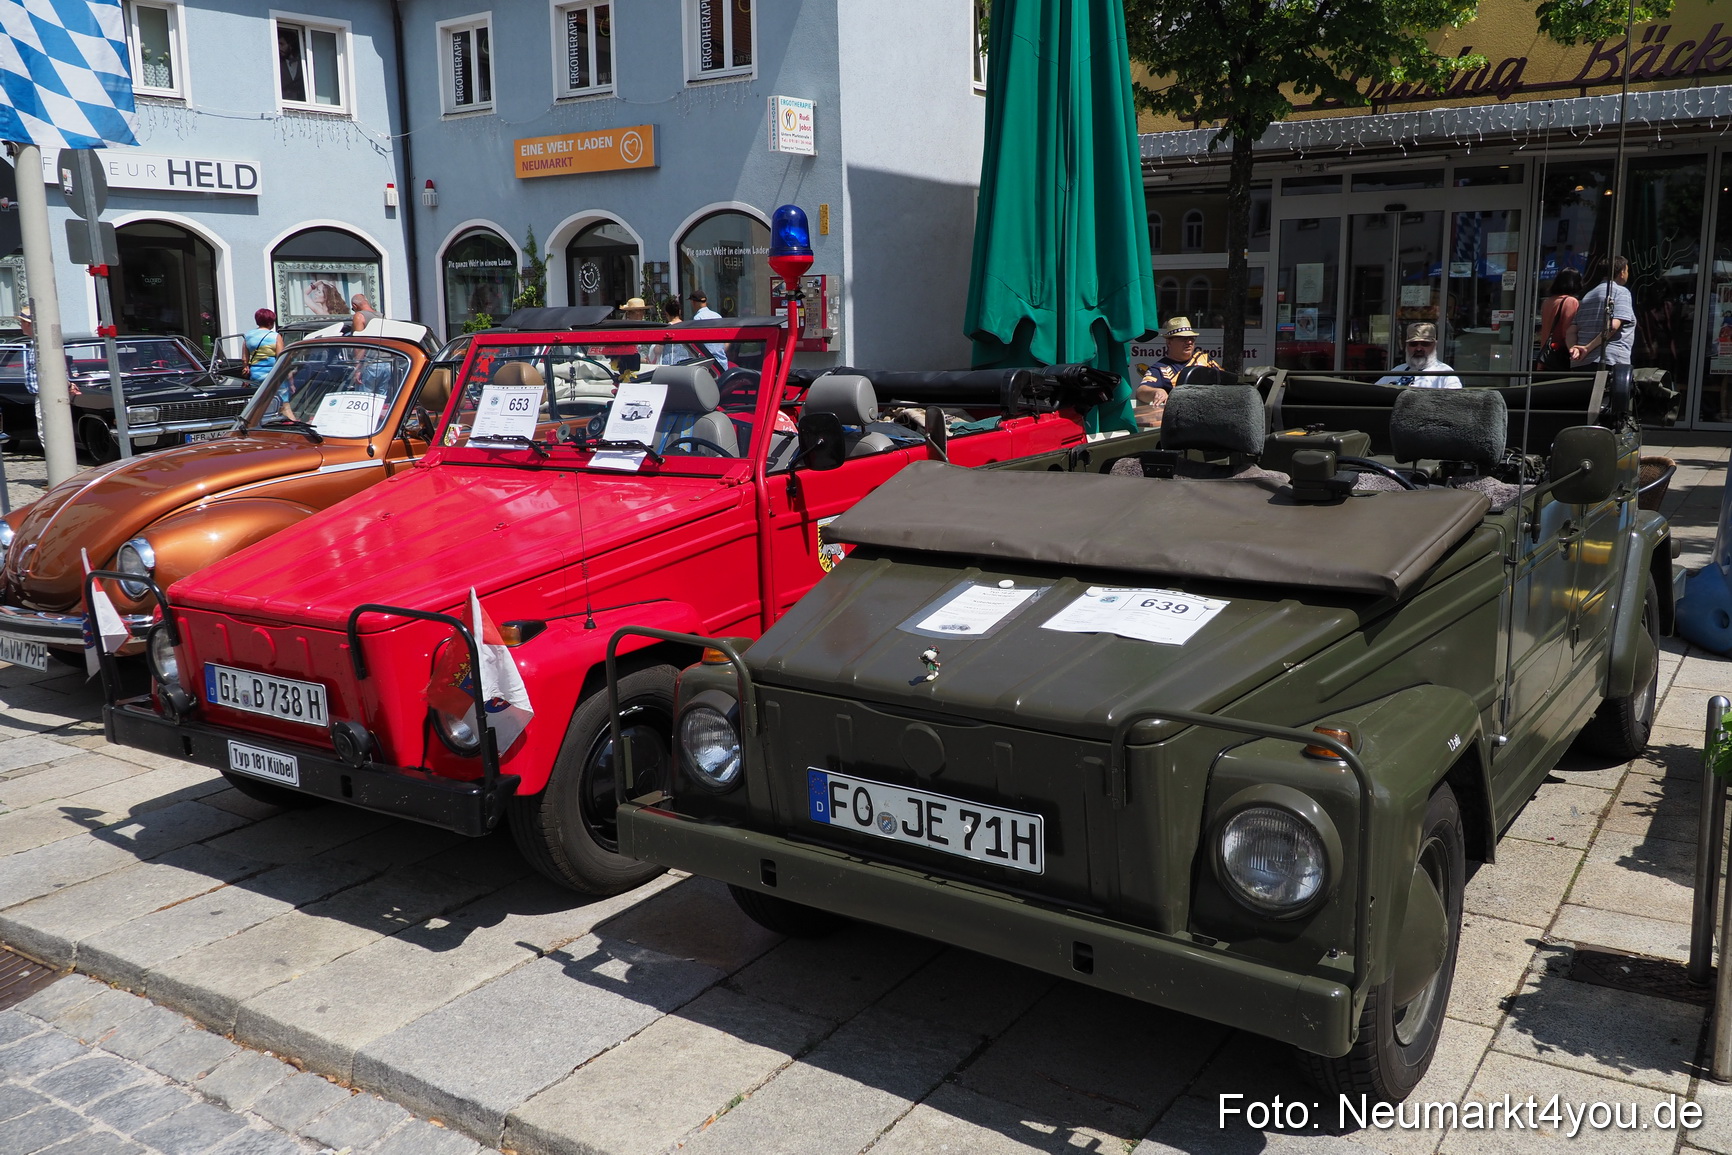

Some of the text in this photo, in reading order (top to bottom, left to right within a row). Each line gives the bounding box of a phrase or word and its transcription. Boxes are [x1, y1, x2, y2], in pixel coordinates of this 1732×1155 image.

[568, 13, 579, 85] ERGOTHERAPIE
[453, 36, 464, 102] ERGOTHERAPIE
[780, 99, 812, 109] ERGOTHERAPIE
[521, 136, 613, 156] EINE WELT LADEN
[522, 157, 573, 171] NEUMARKT
[168, 159, 257, 190] HELD
[696, 248, 712, 257] ganze
[713, 246, 727, 255] Welt
[728, 247, 734, 255] in
[734, 247, 751, 255] einem
[455, 261, 468, 269] ganze
[468, 259, 479, 267] Welt
[1132, 346, 1257, 358] Snack Croint
[346, 400, 369, 411] 280
[509, 398, 529, 411] 653
[1140, 598, 1190, 614] 639
[25, 644, 44, 667] 79H
[220, 672, 239, 703] GI
[233, 748, 294, 778] Typ 181 Kübel
[816, 781, 1037, 864] D FO JE 71H
